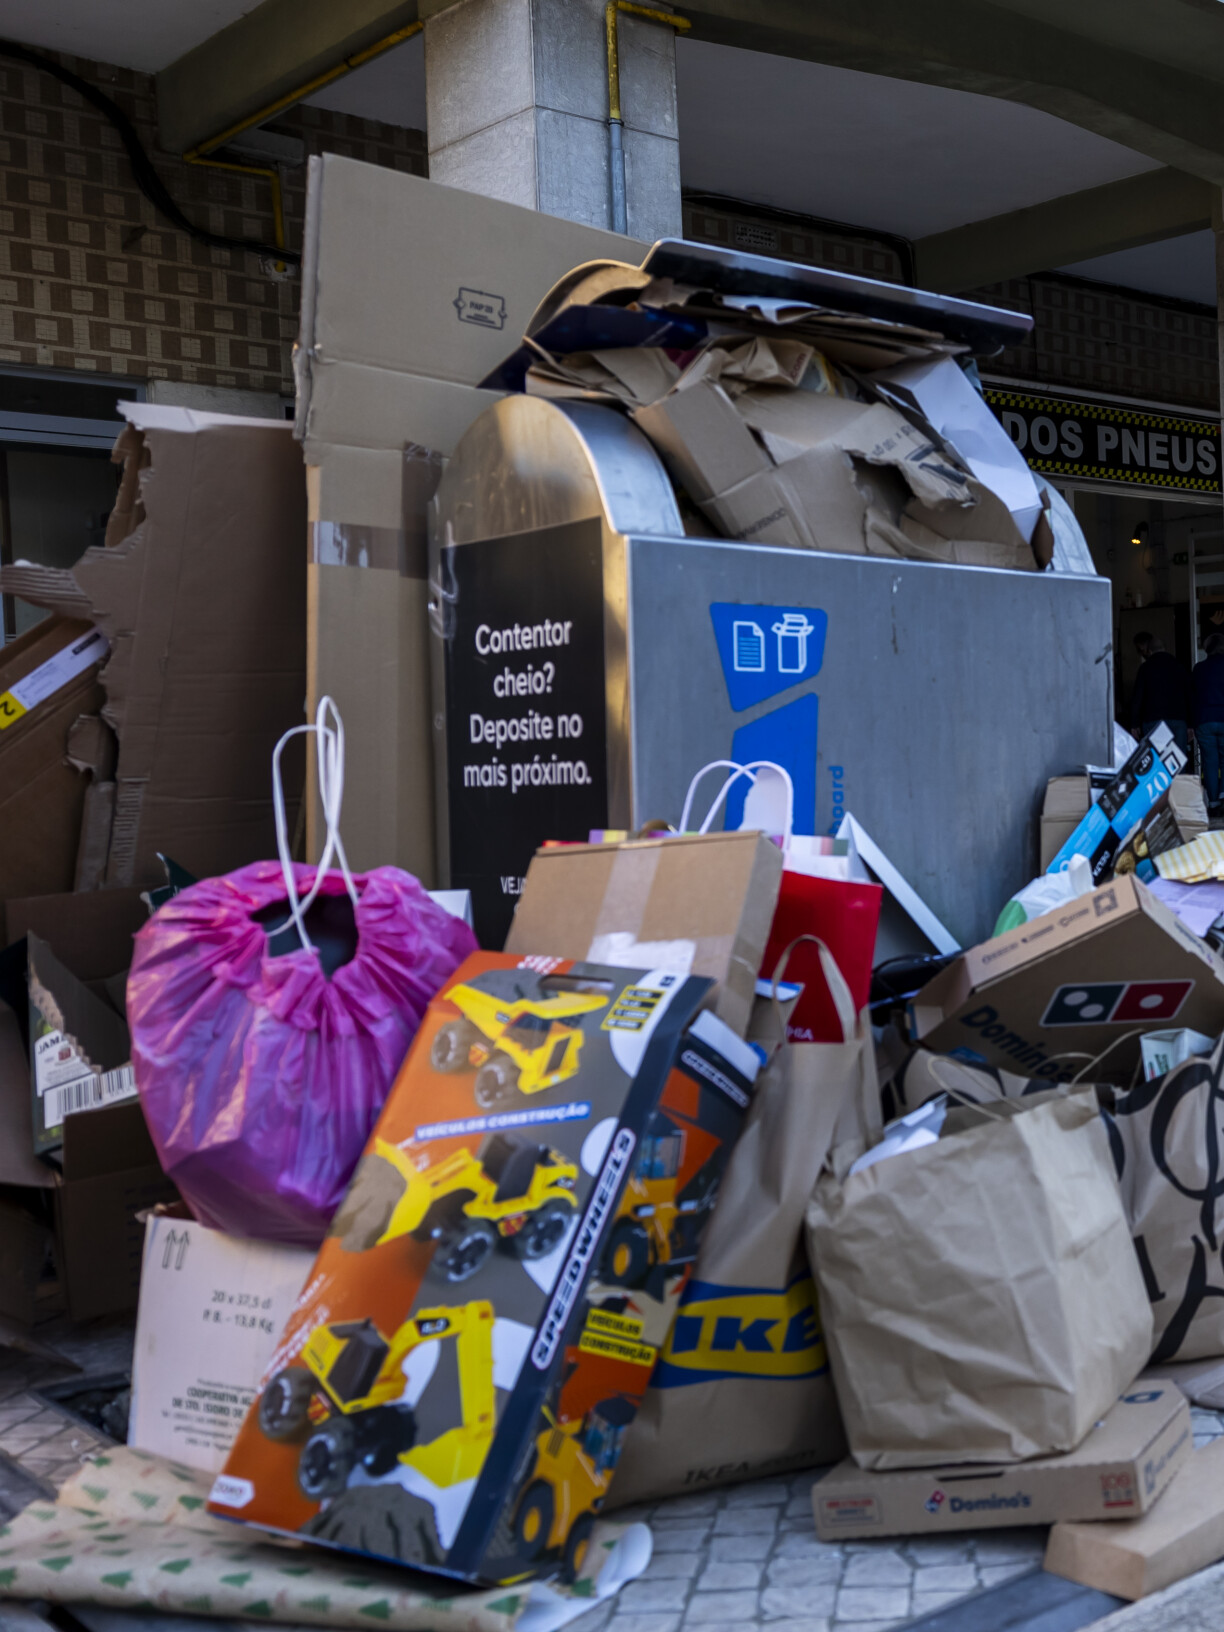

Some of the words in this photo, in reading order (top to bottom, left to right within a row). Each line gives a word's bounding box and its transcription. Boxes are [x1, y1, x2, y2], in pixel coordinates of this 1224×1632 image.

[1001, 410, 1084, 459] DOS
[1096, 424, 1217, 476] PNEUS
[475, 618, 574, 656] Contentor
[492, 661, 556, 698] cheio?
[469, 709, 554, 750] Deposite
[557, 713, 584, 739] no
[463, 756, 508, 788] mais
[510, 754, 592, 794] próximo.
[487, 1102, 590, 1129] CONSTRUÇÃO
[211, 1289, 225, 1303] 20
[670, 1303, 821, 1355] IKE
[950, 1490, 1032, 1514] Domino's
